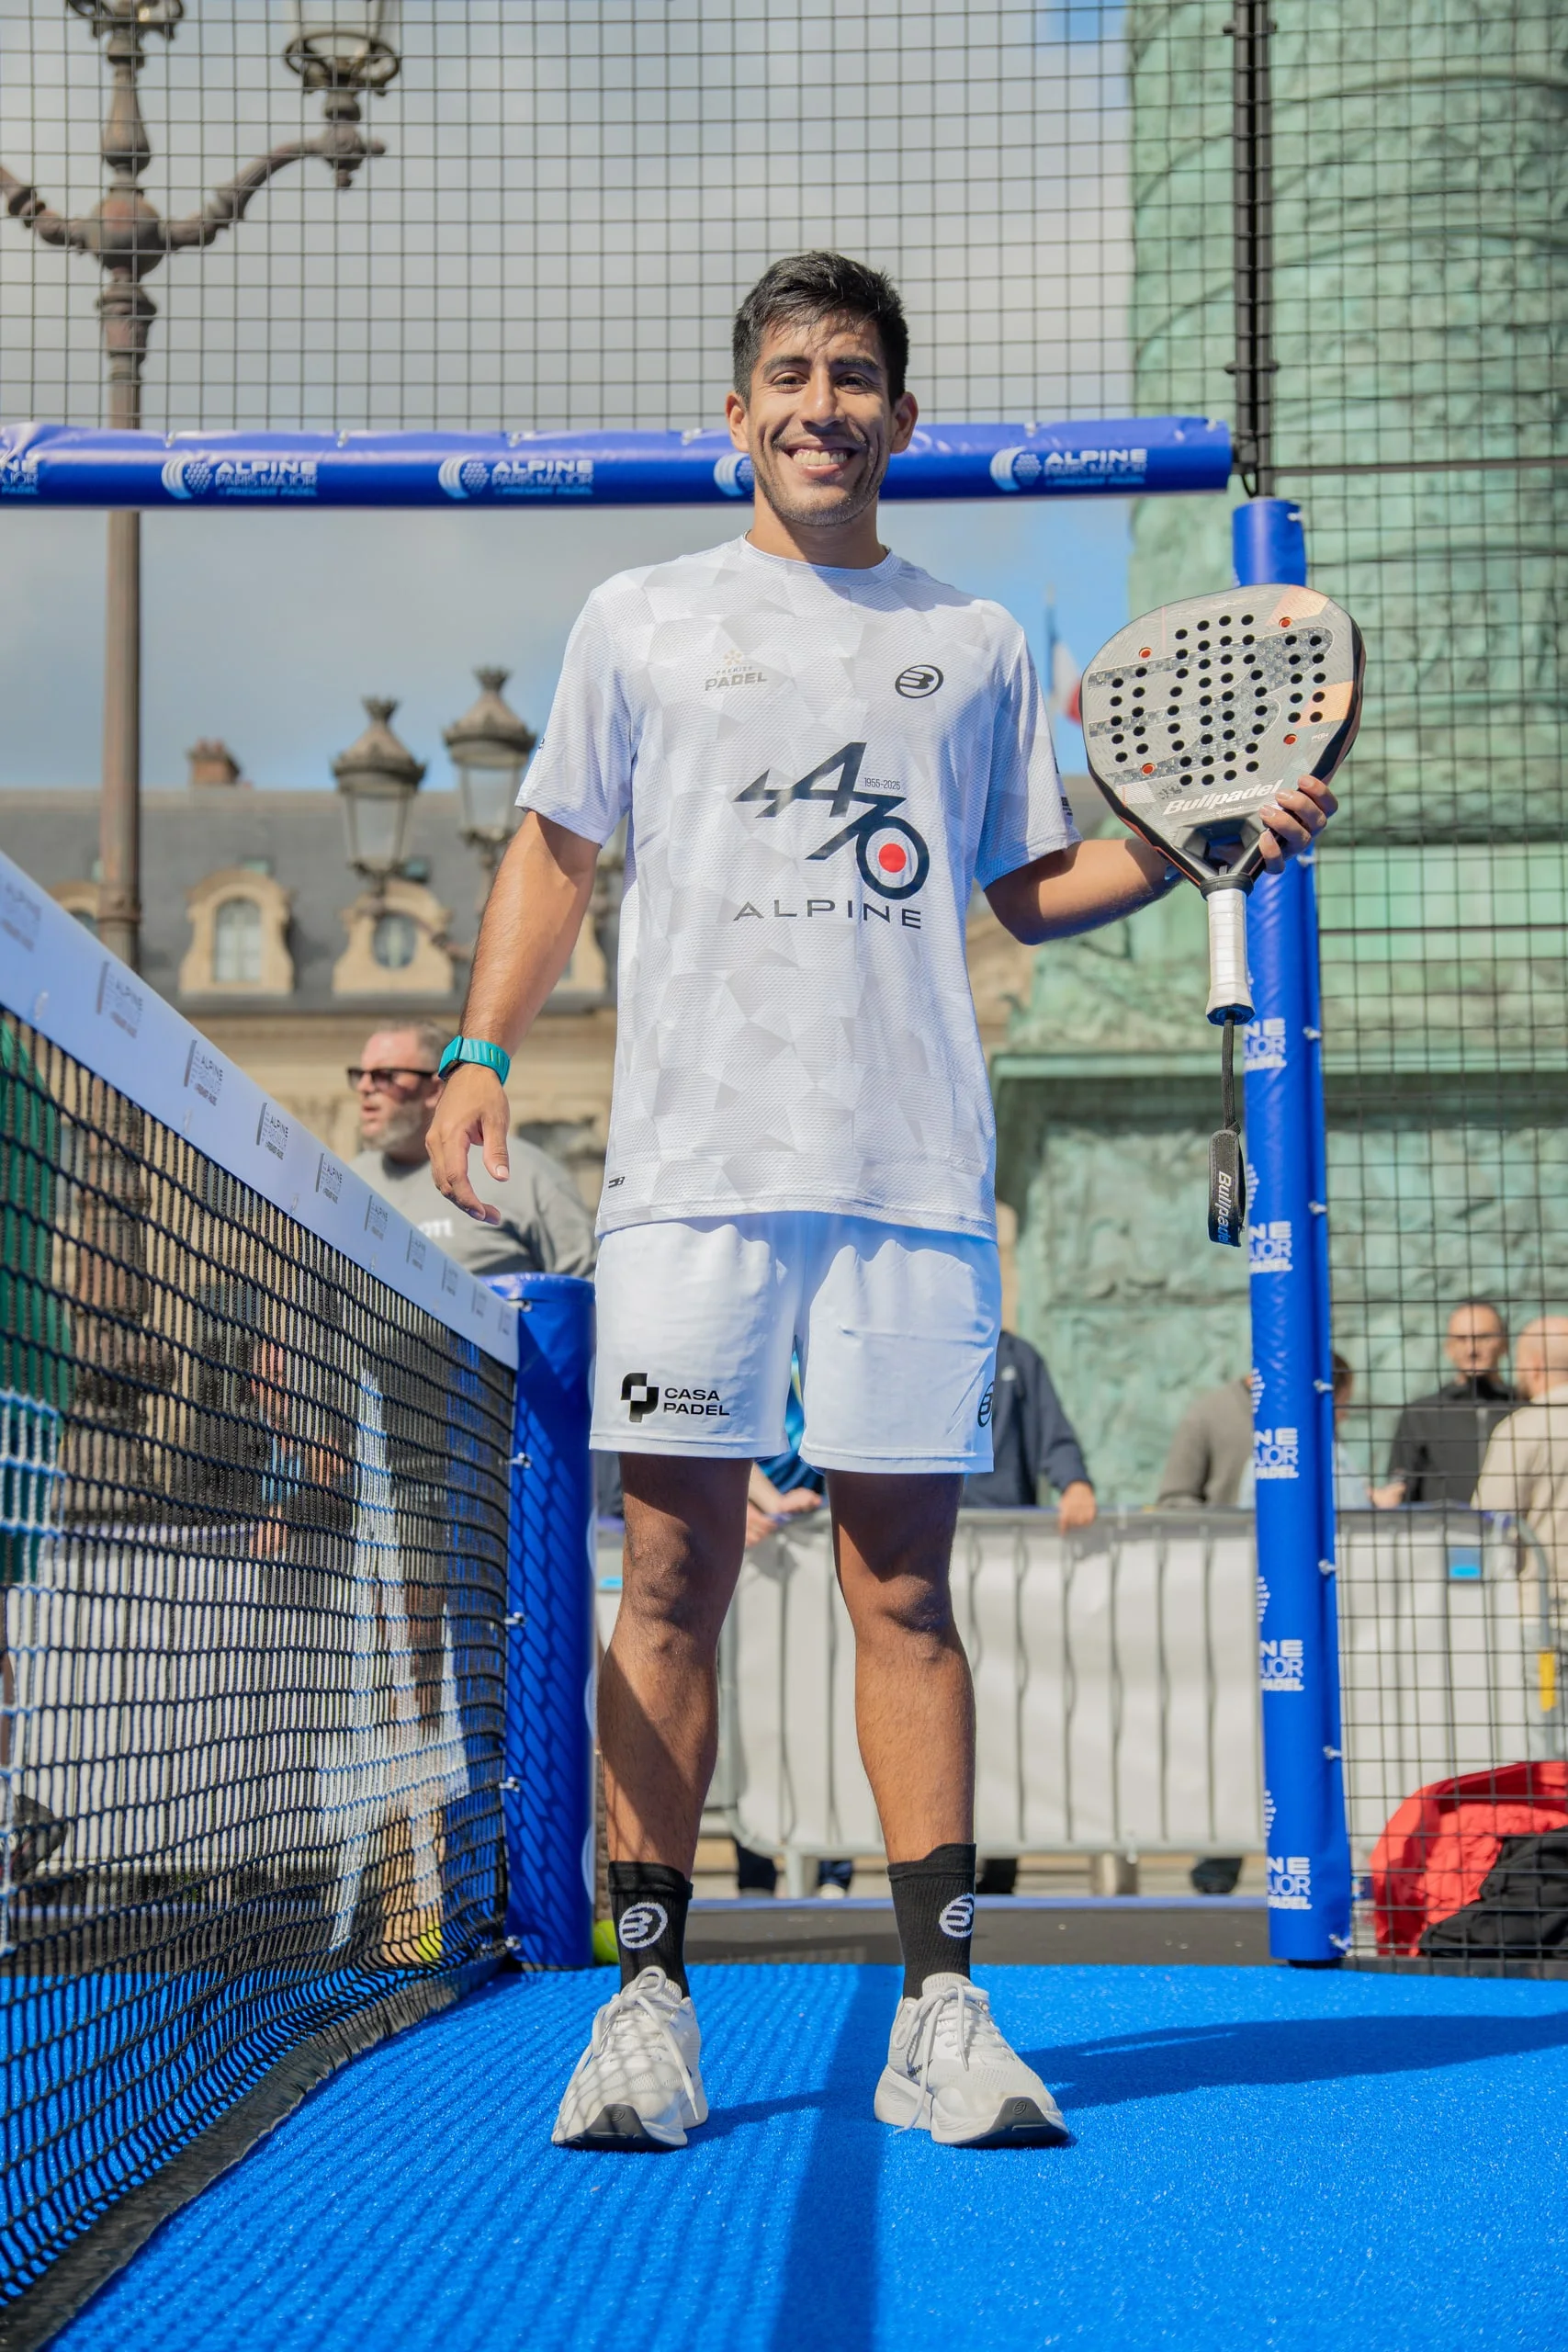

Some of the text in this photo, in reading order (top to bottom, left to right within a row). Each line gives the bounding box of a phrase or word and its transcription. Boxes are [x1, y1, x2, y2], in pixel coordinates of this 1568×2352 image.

[1045, 448, 1147, 466] ALPINE
[216, 460, 317, 475] ALPINE
[491, 459, 593, 474] ALPINE
[260, 473, 318, 486] MAJOR
[705, 672, 767, 691] PADEL
[863, 777, 901, 790] 1955-2025
[1162, 778, 1284, 816] Bullpadel
[733, 899, 922, 930] ALPINE
[664, 1387, 721, 1402] CASA
[663, 1402, 731, 1417] PADEL
